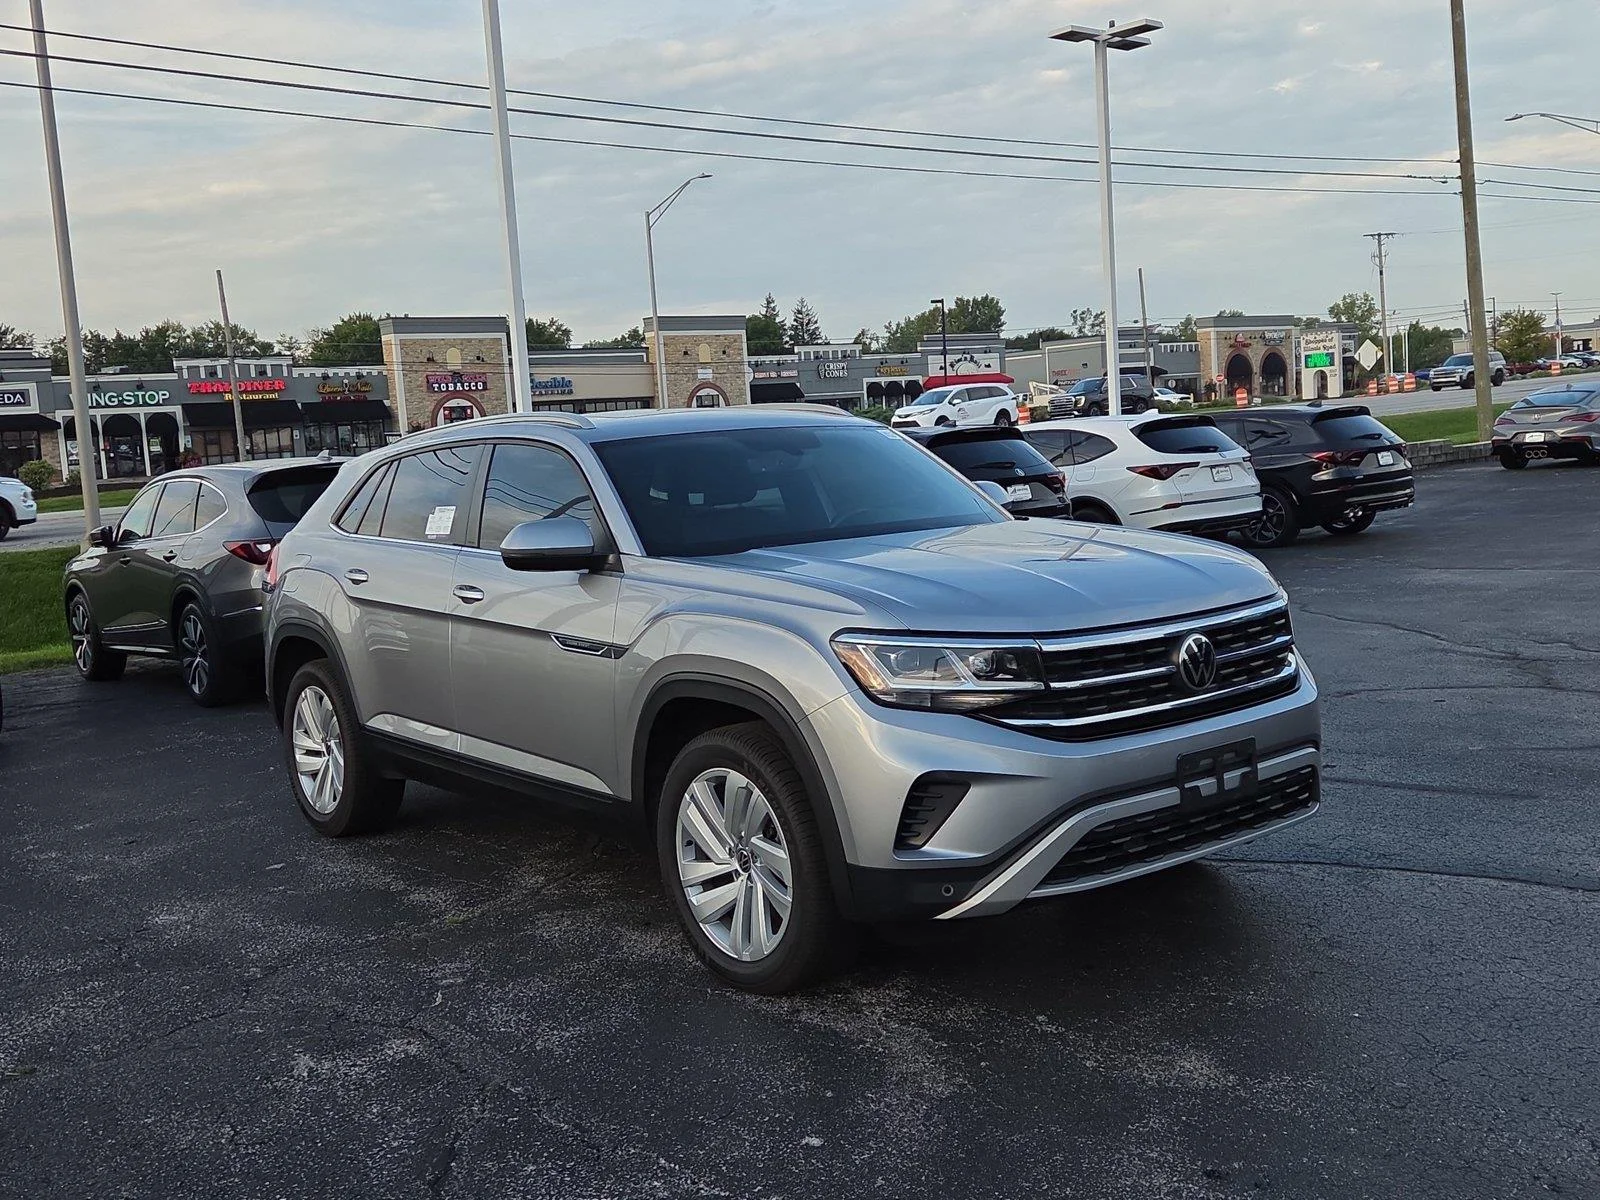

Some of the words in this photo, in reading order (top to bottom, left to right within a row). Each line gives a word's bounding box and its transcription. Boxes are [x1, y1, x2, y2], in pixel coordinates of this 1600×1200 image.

[825, 362, 848, 370] CRISPY
[826, 370, 848, 378] CONES
[237, 379, 285, 391] DINER
[433, 382, 483, 391] TOBACCO
[530, 377, 573, 389] lexible
